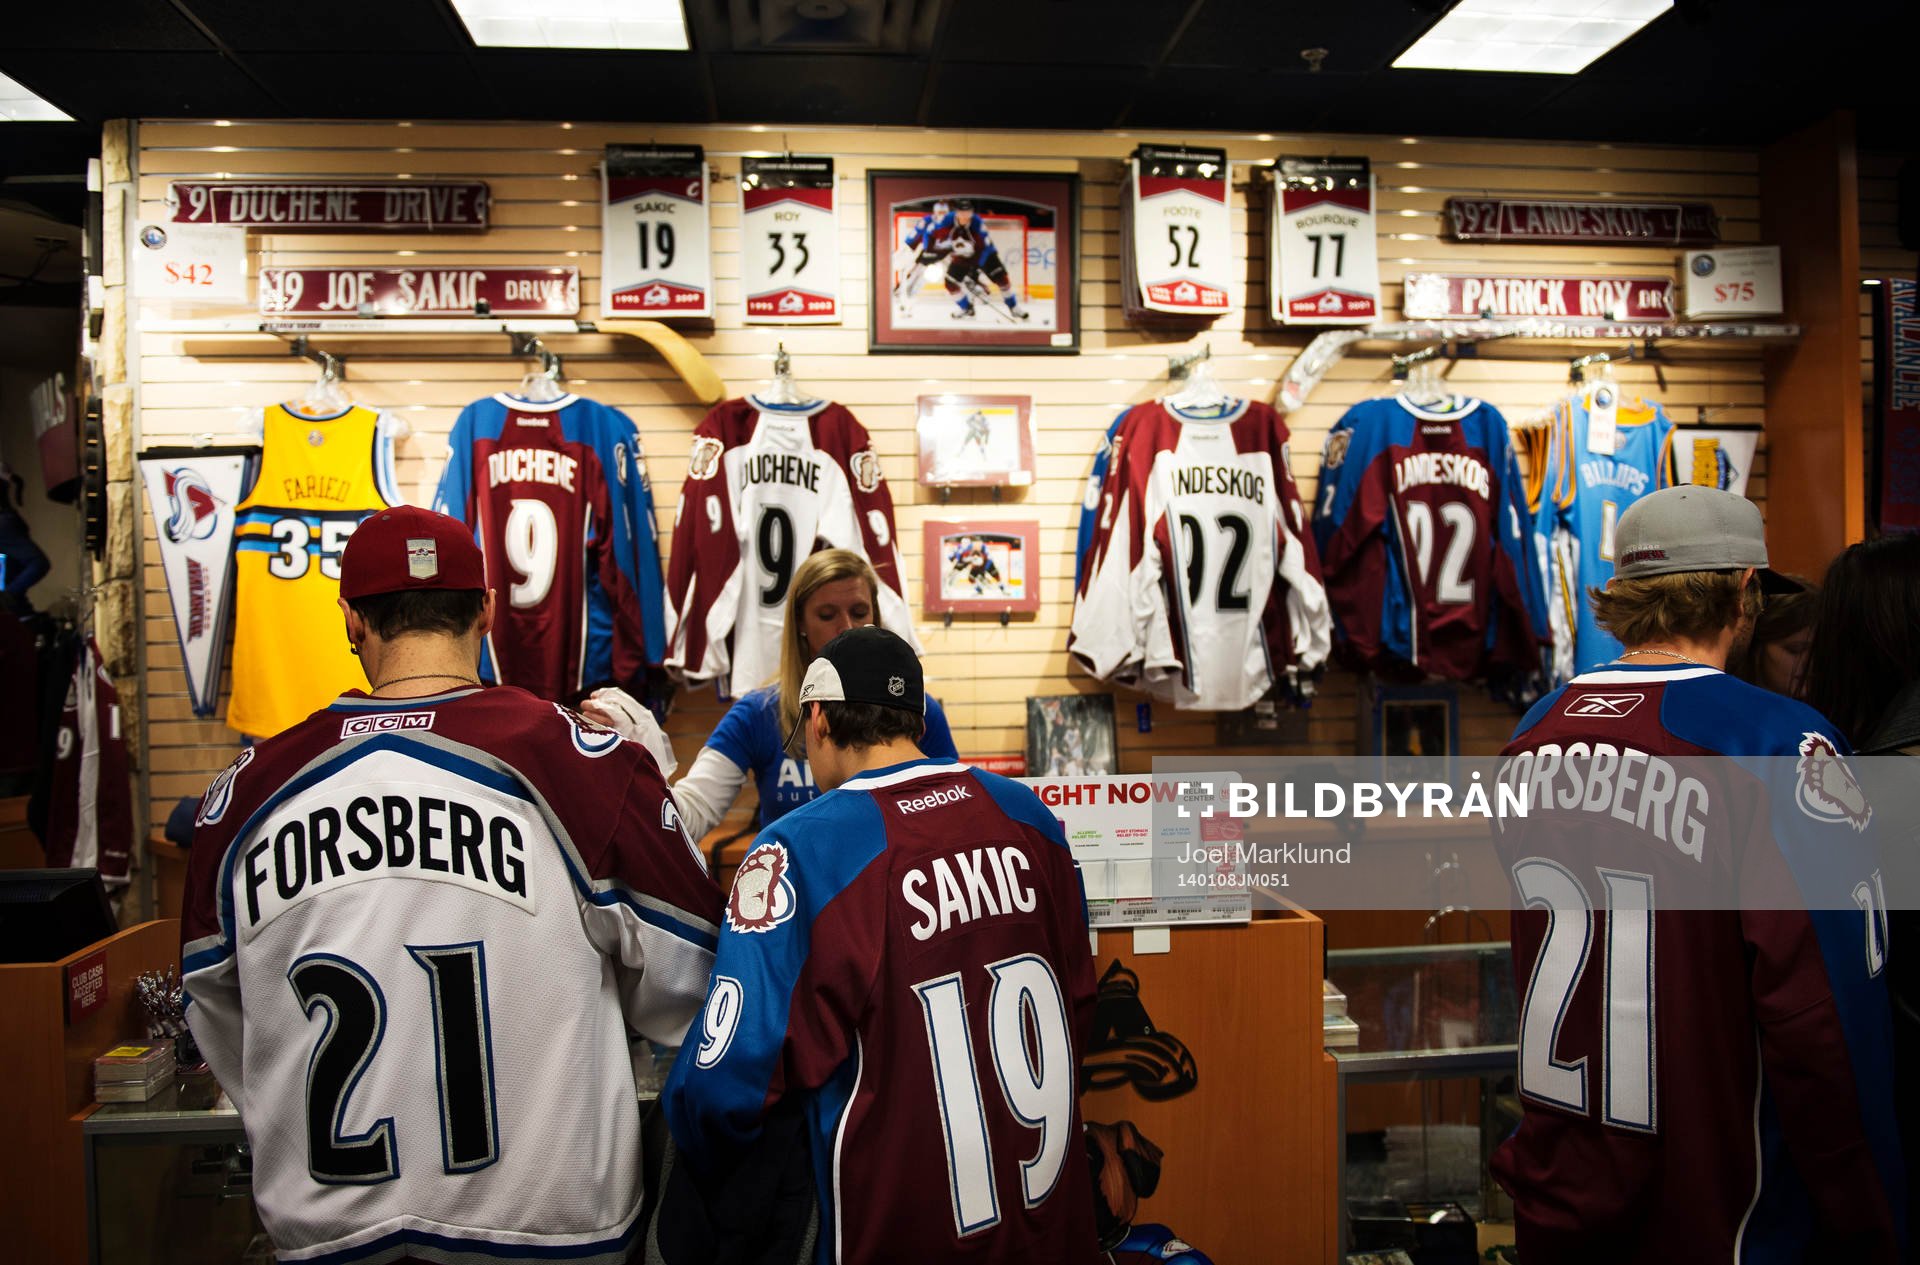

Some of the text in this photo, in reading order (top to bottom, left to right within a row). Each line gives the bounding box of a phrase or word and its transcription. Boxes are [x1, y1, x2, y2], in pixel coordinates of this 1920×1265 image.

[189, 186, 468, 223] 9 DUCHENE DRIVE
[634, 203, 675, 215] SAKIC
[774, 211, 800, 222] ROY
[1163, 206, 1202, 218] FOOTE
[1508, 203, 1656, 236] LANDESKOG
[637, 221, 675, 270] 19
[768, 231, 810, 277] 33
[1168, 225, 1200, 268] 52
[1307, 233, 1346, 278] 77
[164, 261, 214, 286] $42
[319, 271, 374, 311] JOE
[399, 271, 488, 312] SAKIC
[505, 280, 565, 302] DRIVE
[1714, 281, 1755, 302] $75
[1462, 278, 1567, 316] PATRICK
[1580, 280, 1632, 316] ROY
[283, 475, 352, 503] FARIED
[488, 448, 578, 494] DUCHENE
[1171, 466, 1266, 506] NDESKOG
[1580, 460, 1649, 497] BILLUPS
[504, 499, 558, 609] 9
[754, 503, 797, 608] 9
[350, 716, 428, 732] CCM
[896, 784, 972, 815] Reebok
[1108, 781, 1180, 806] NOW
[245, 795, 528, 927] FORSBERG
[902, 846, 1037, 941] SAKIC
[72, 964, 103, 989] CLUB CASH
[74, 976, 102, 1000] ACCEPTED
[1512, 856, 1658, 1134] 21
[82, 991, 97, 1009] HERE
[288, 940, 500, 1186] 21
[910, 952, 1075, 1239] 19
